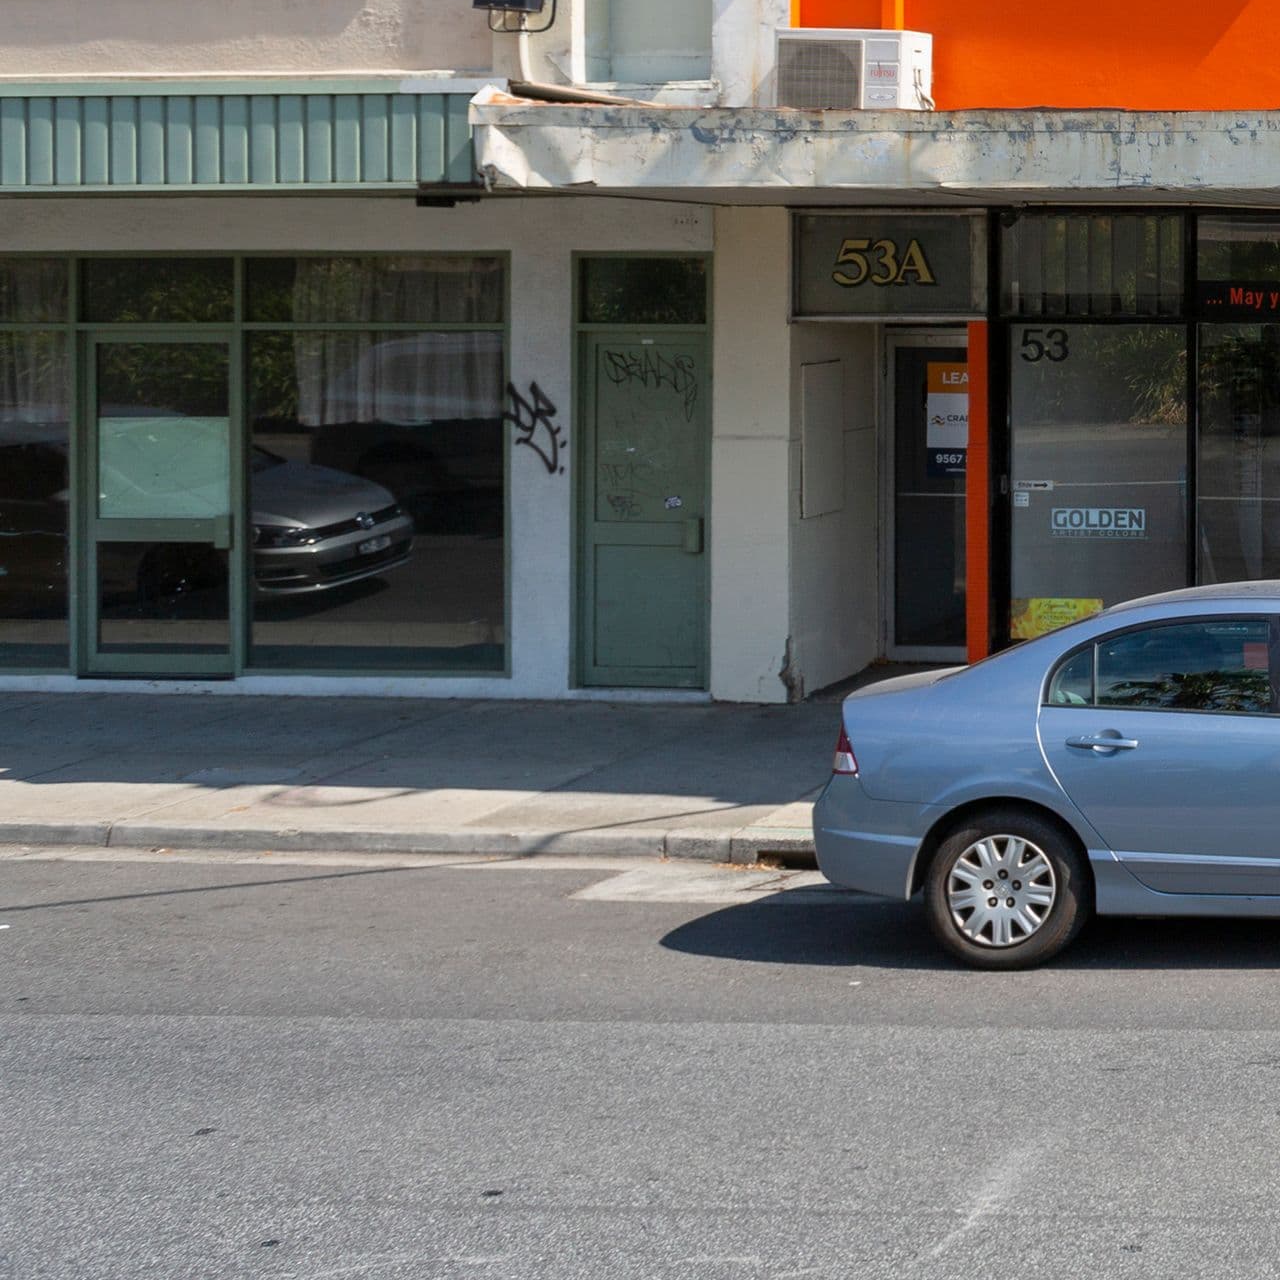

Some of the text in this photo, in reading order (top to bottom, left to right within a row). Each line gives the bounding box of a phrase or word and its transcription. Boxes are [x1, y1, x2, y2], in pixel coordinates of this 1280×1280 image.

[832, 238, 937, 288] 53A
[1230, 287, 1264, 309] May
[1020, 328, 1070, 362] 53
[942, 372, 968, 385] LEA
[936, 454, 963, 464] 9567
[1053, 509, 1143, 529] GOLDEN
